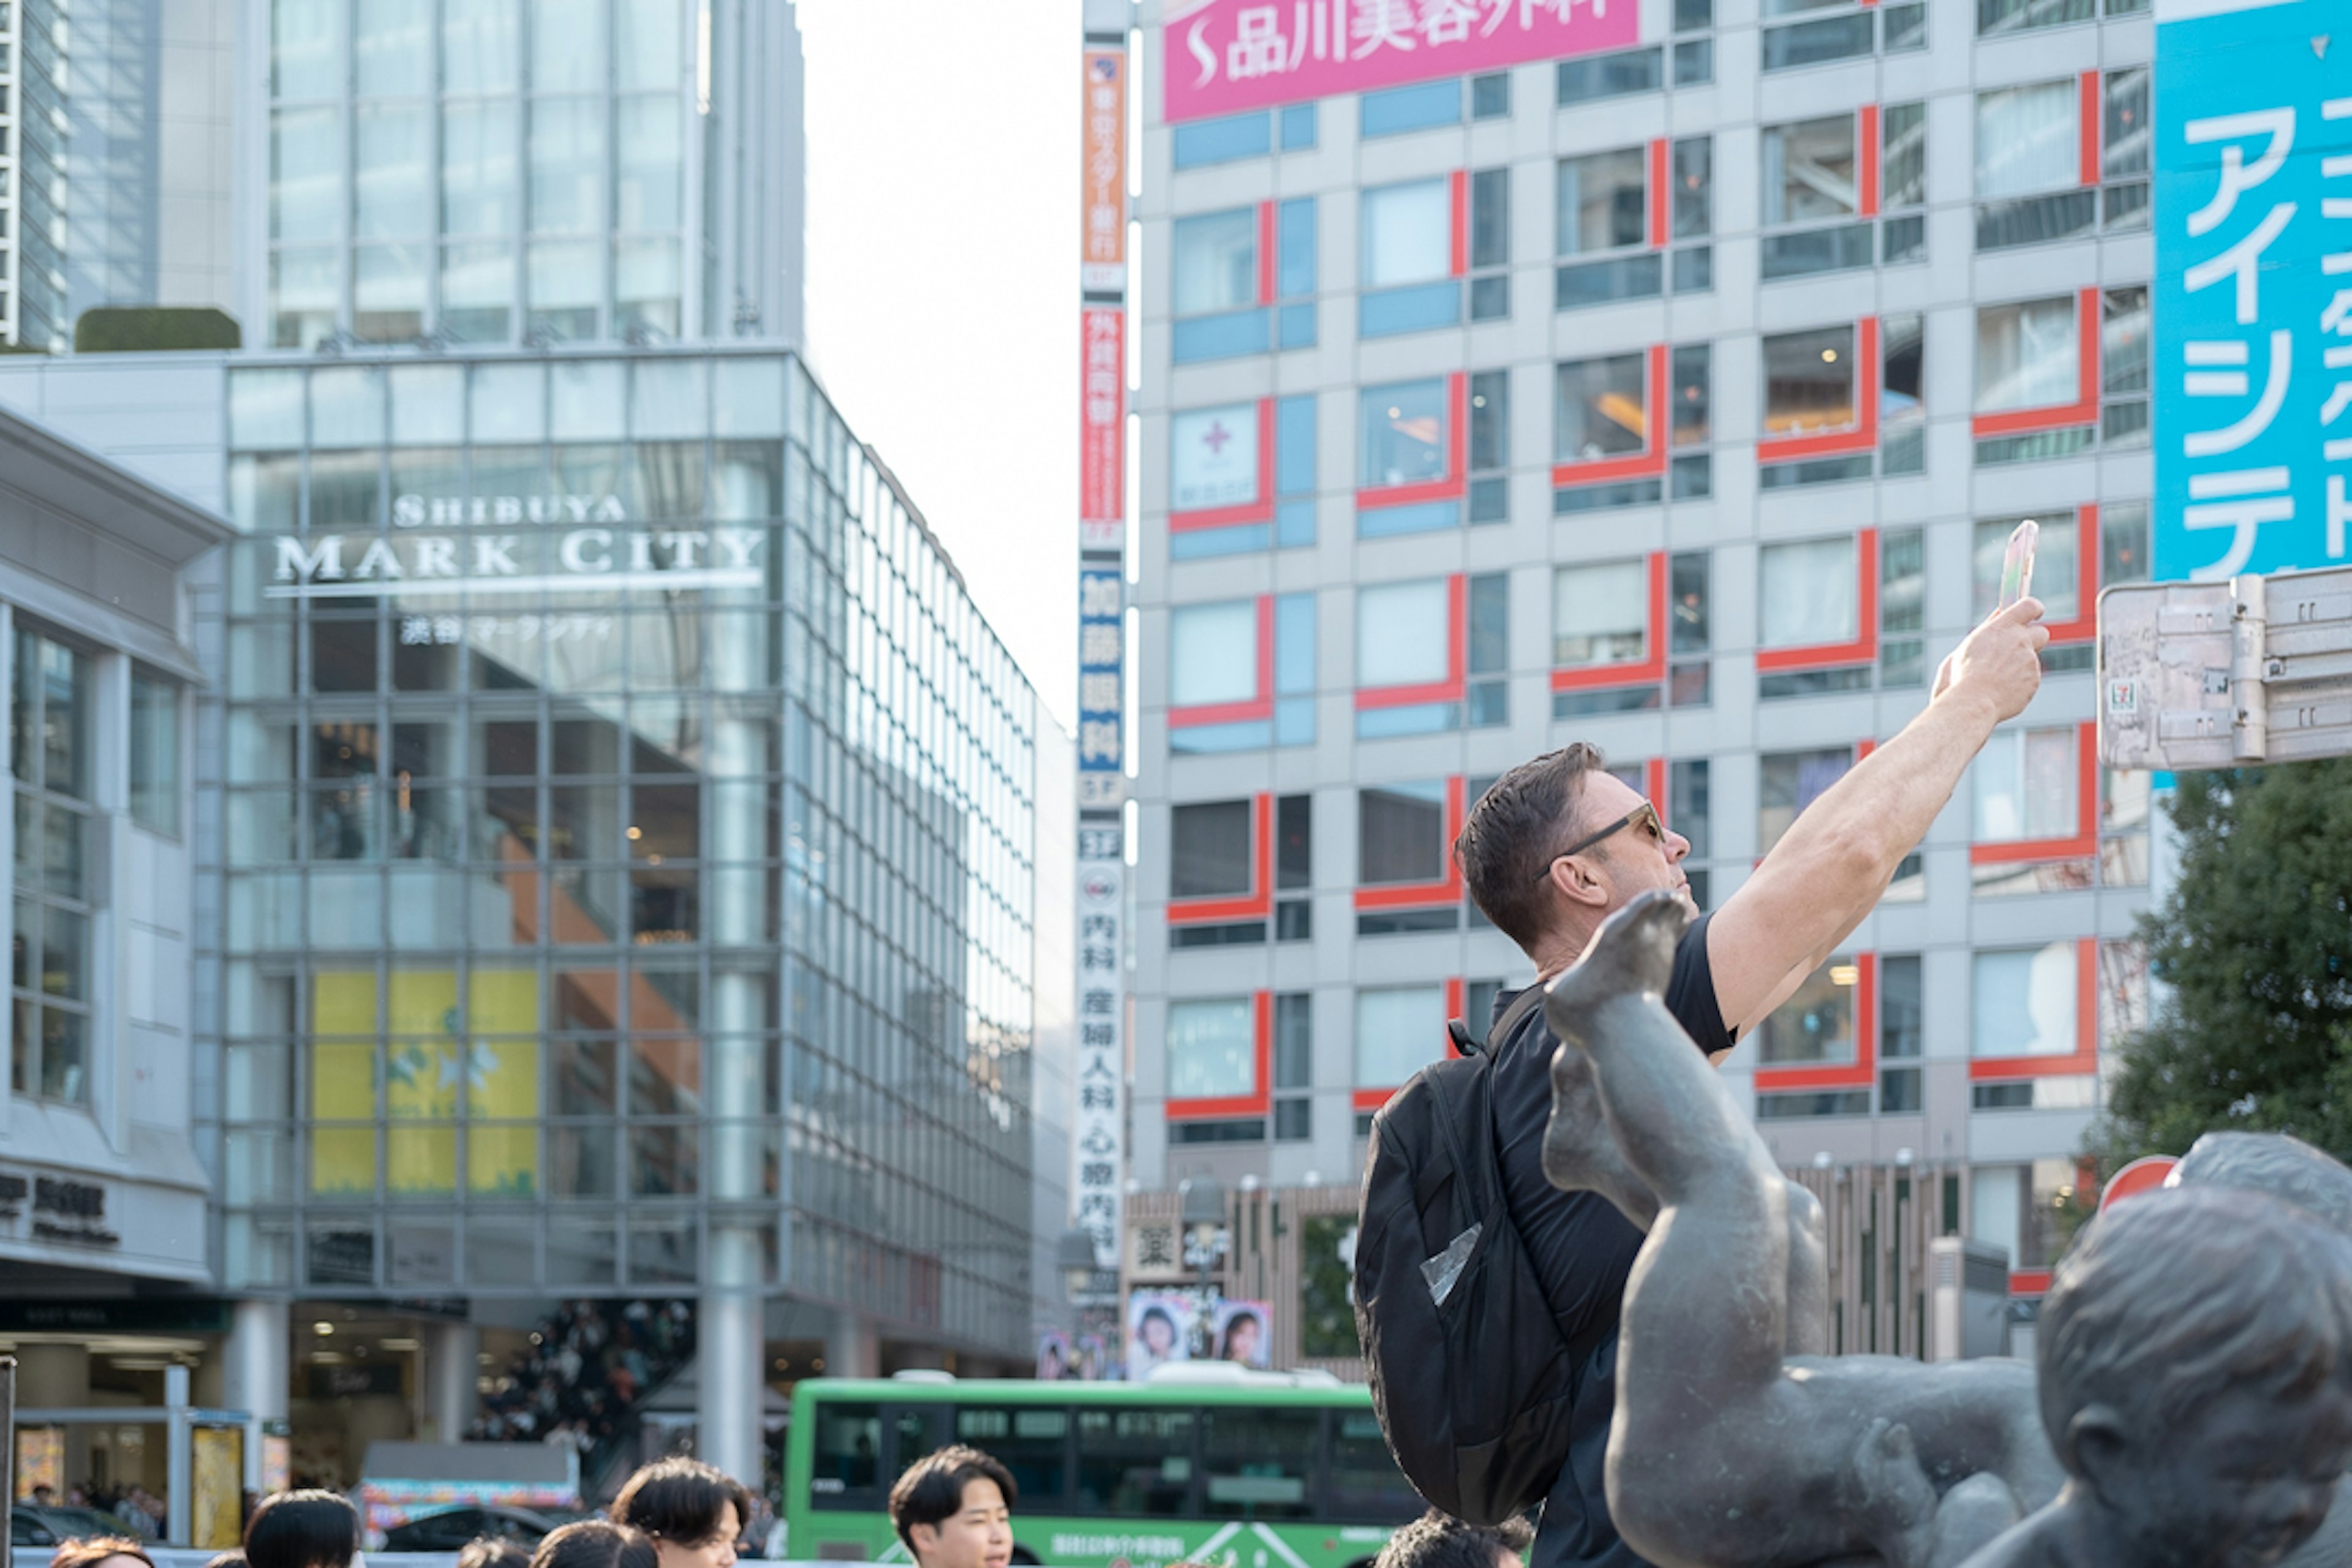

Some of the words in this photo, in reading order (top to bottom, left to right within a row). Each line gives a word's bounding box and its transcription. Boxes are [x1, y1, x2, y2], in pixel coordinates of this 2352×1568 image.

[2184, 106, 2297, 581] アイシテ
[393, 492, 627, 527] SHIBUYA
[274, 533, 519, 581] MARK
[560, 528, 764, 574] CITY
